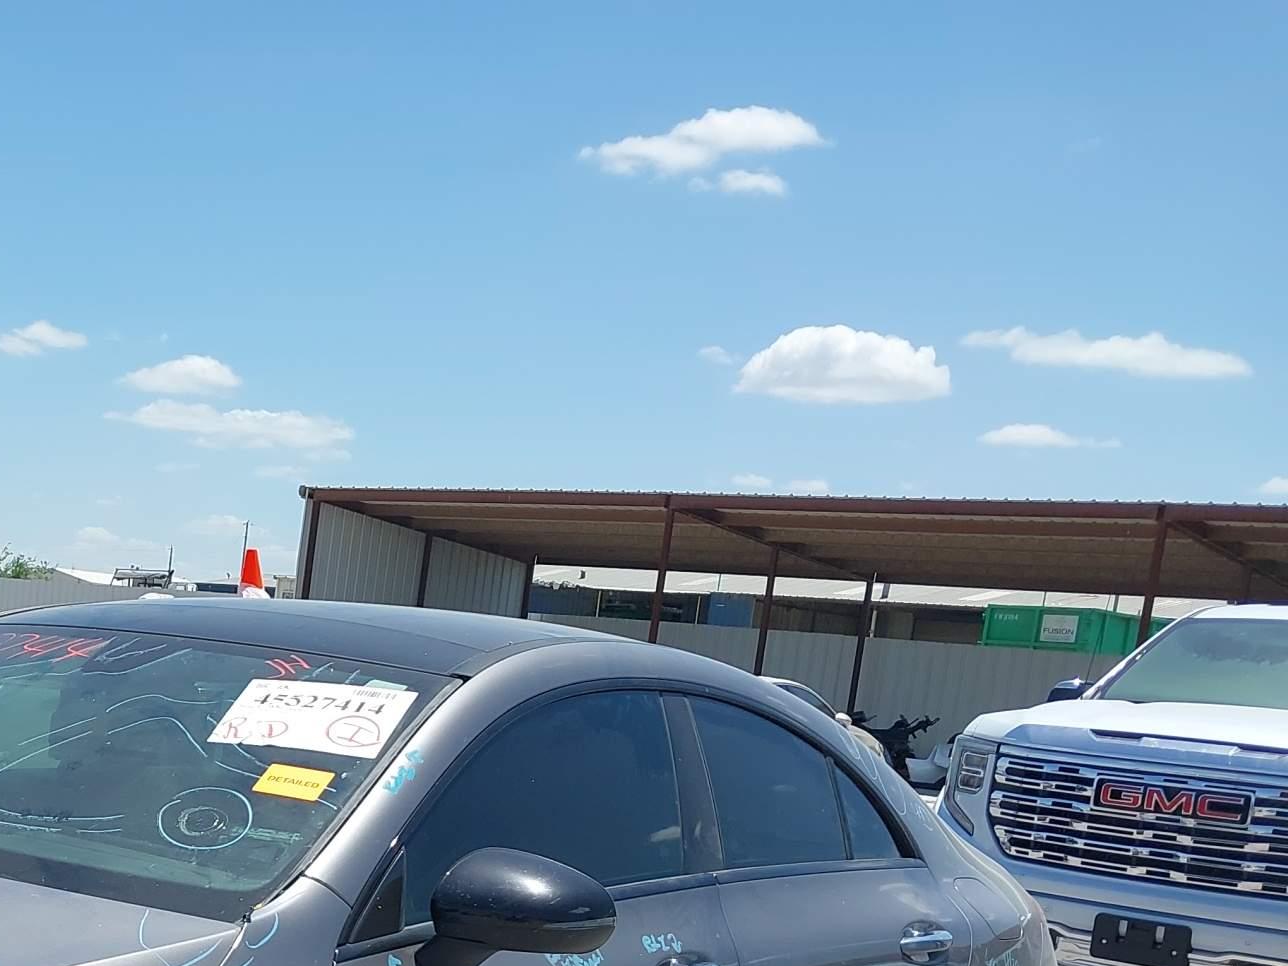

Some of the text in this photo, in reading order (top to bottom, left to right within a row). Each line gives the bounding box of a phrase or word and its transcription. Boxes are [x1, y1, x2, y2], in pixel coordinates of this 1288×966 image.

[254, 693, 386, 715] 45527414
[266, 774, 320, 789] DETAILED
[1100, 782, 1246, 821] GMC
